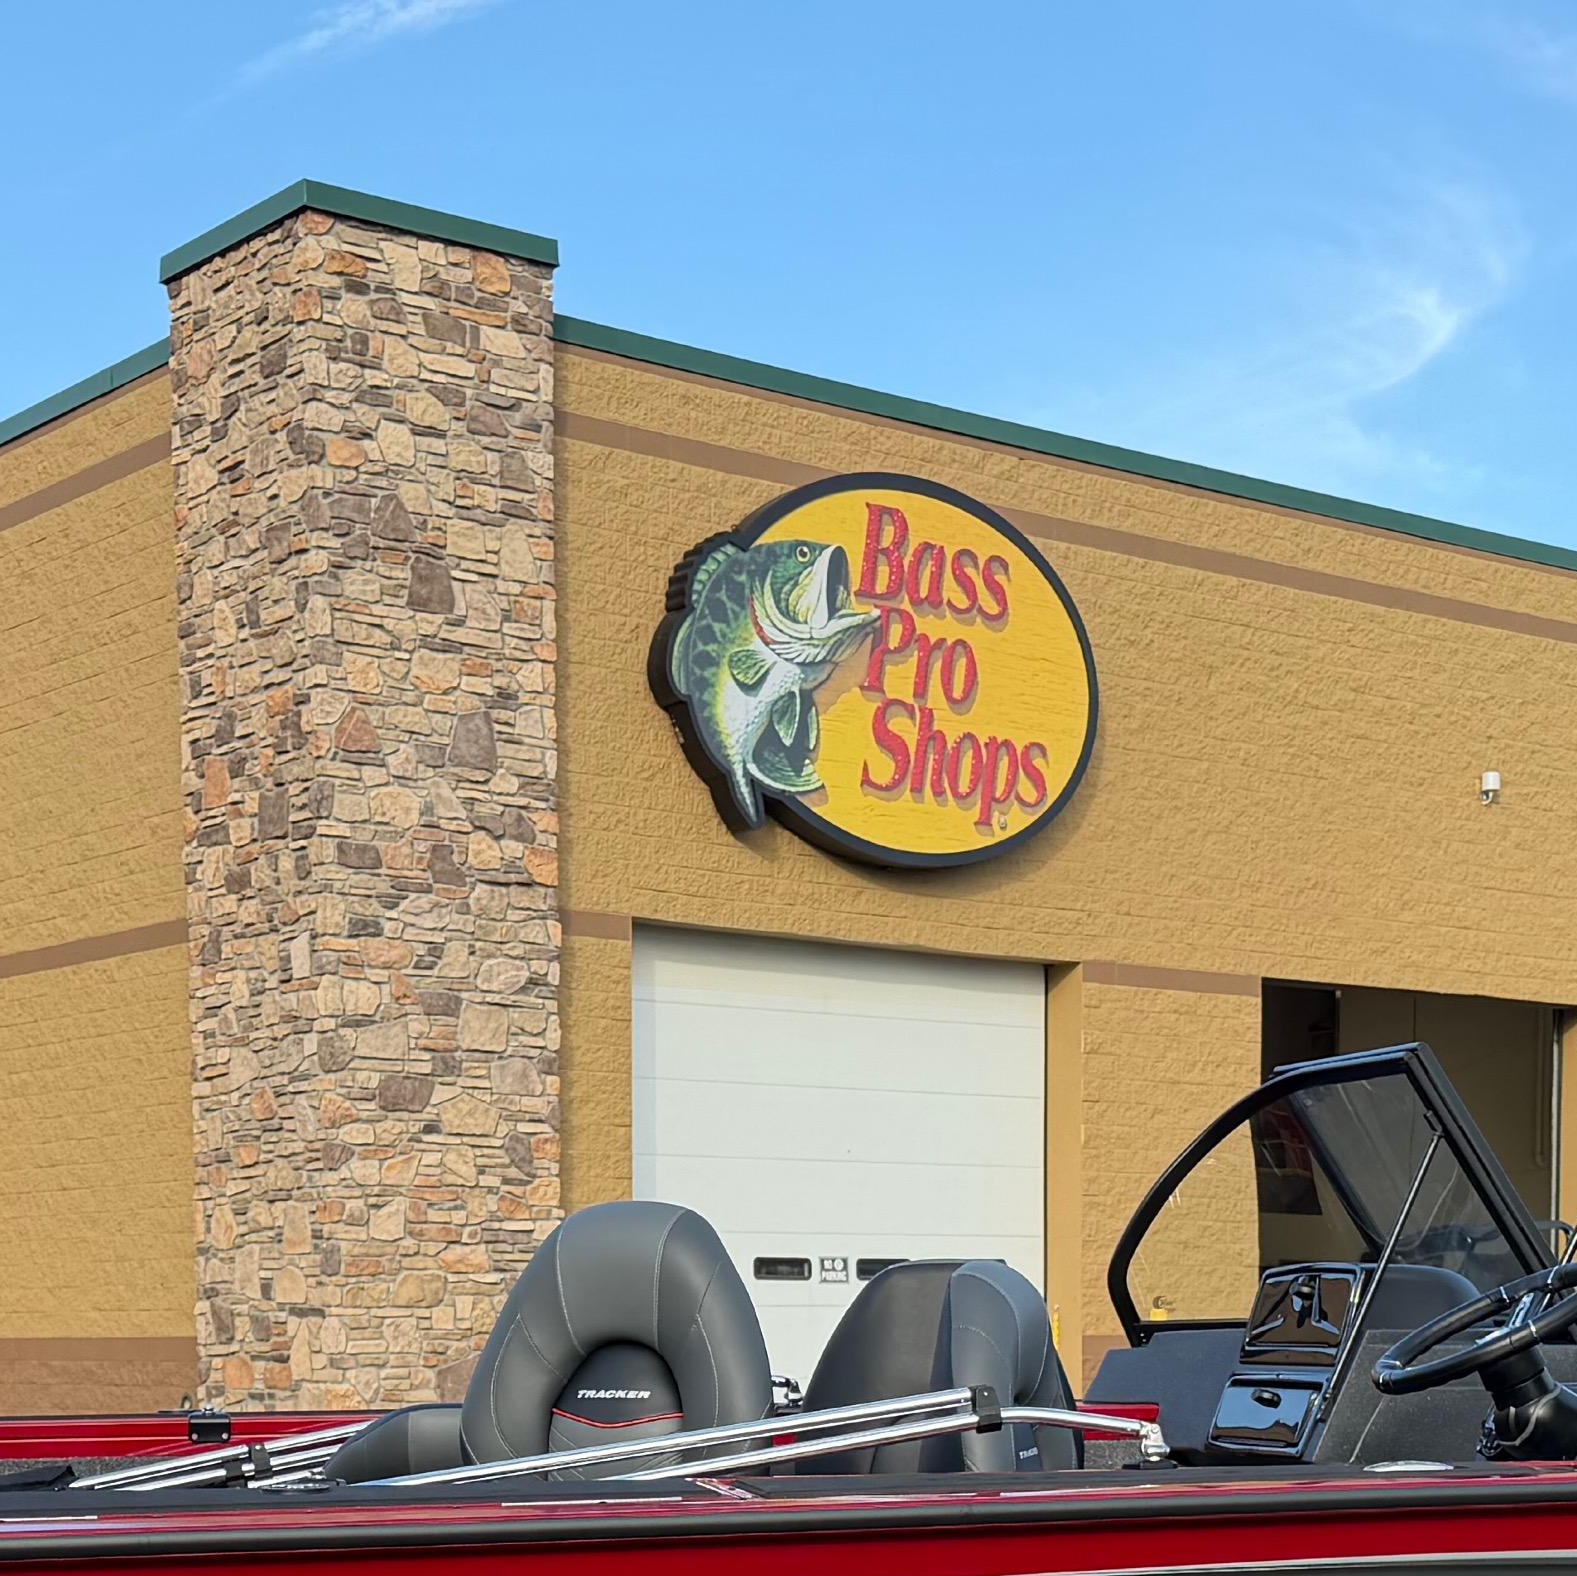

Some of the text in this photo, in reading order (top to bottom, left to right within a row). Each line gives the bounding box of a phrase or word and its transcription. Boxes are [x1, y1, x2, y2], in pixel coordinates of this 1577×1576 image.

[854, 501, 1011, 624] Bass
[860, 603, 978, 706] Pro
[861, 698, 1049, 832] Shops
[577, 1389, 651, 1399] TRACKER
